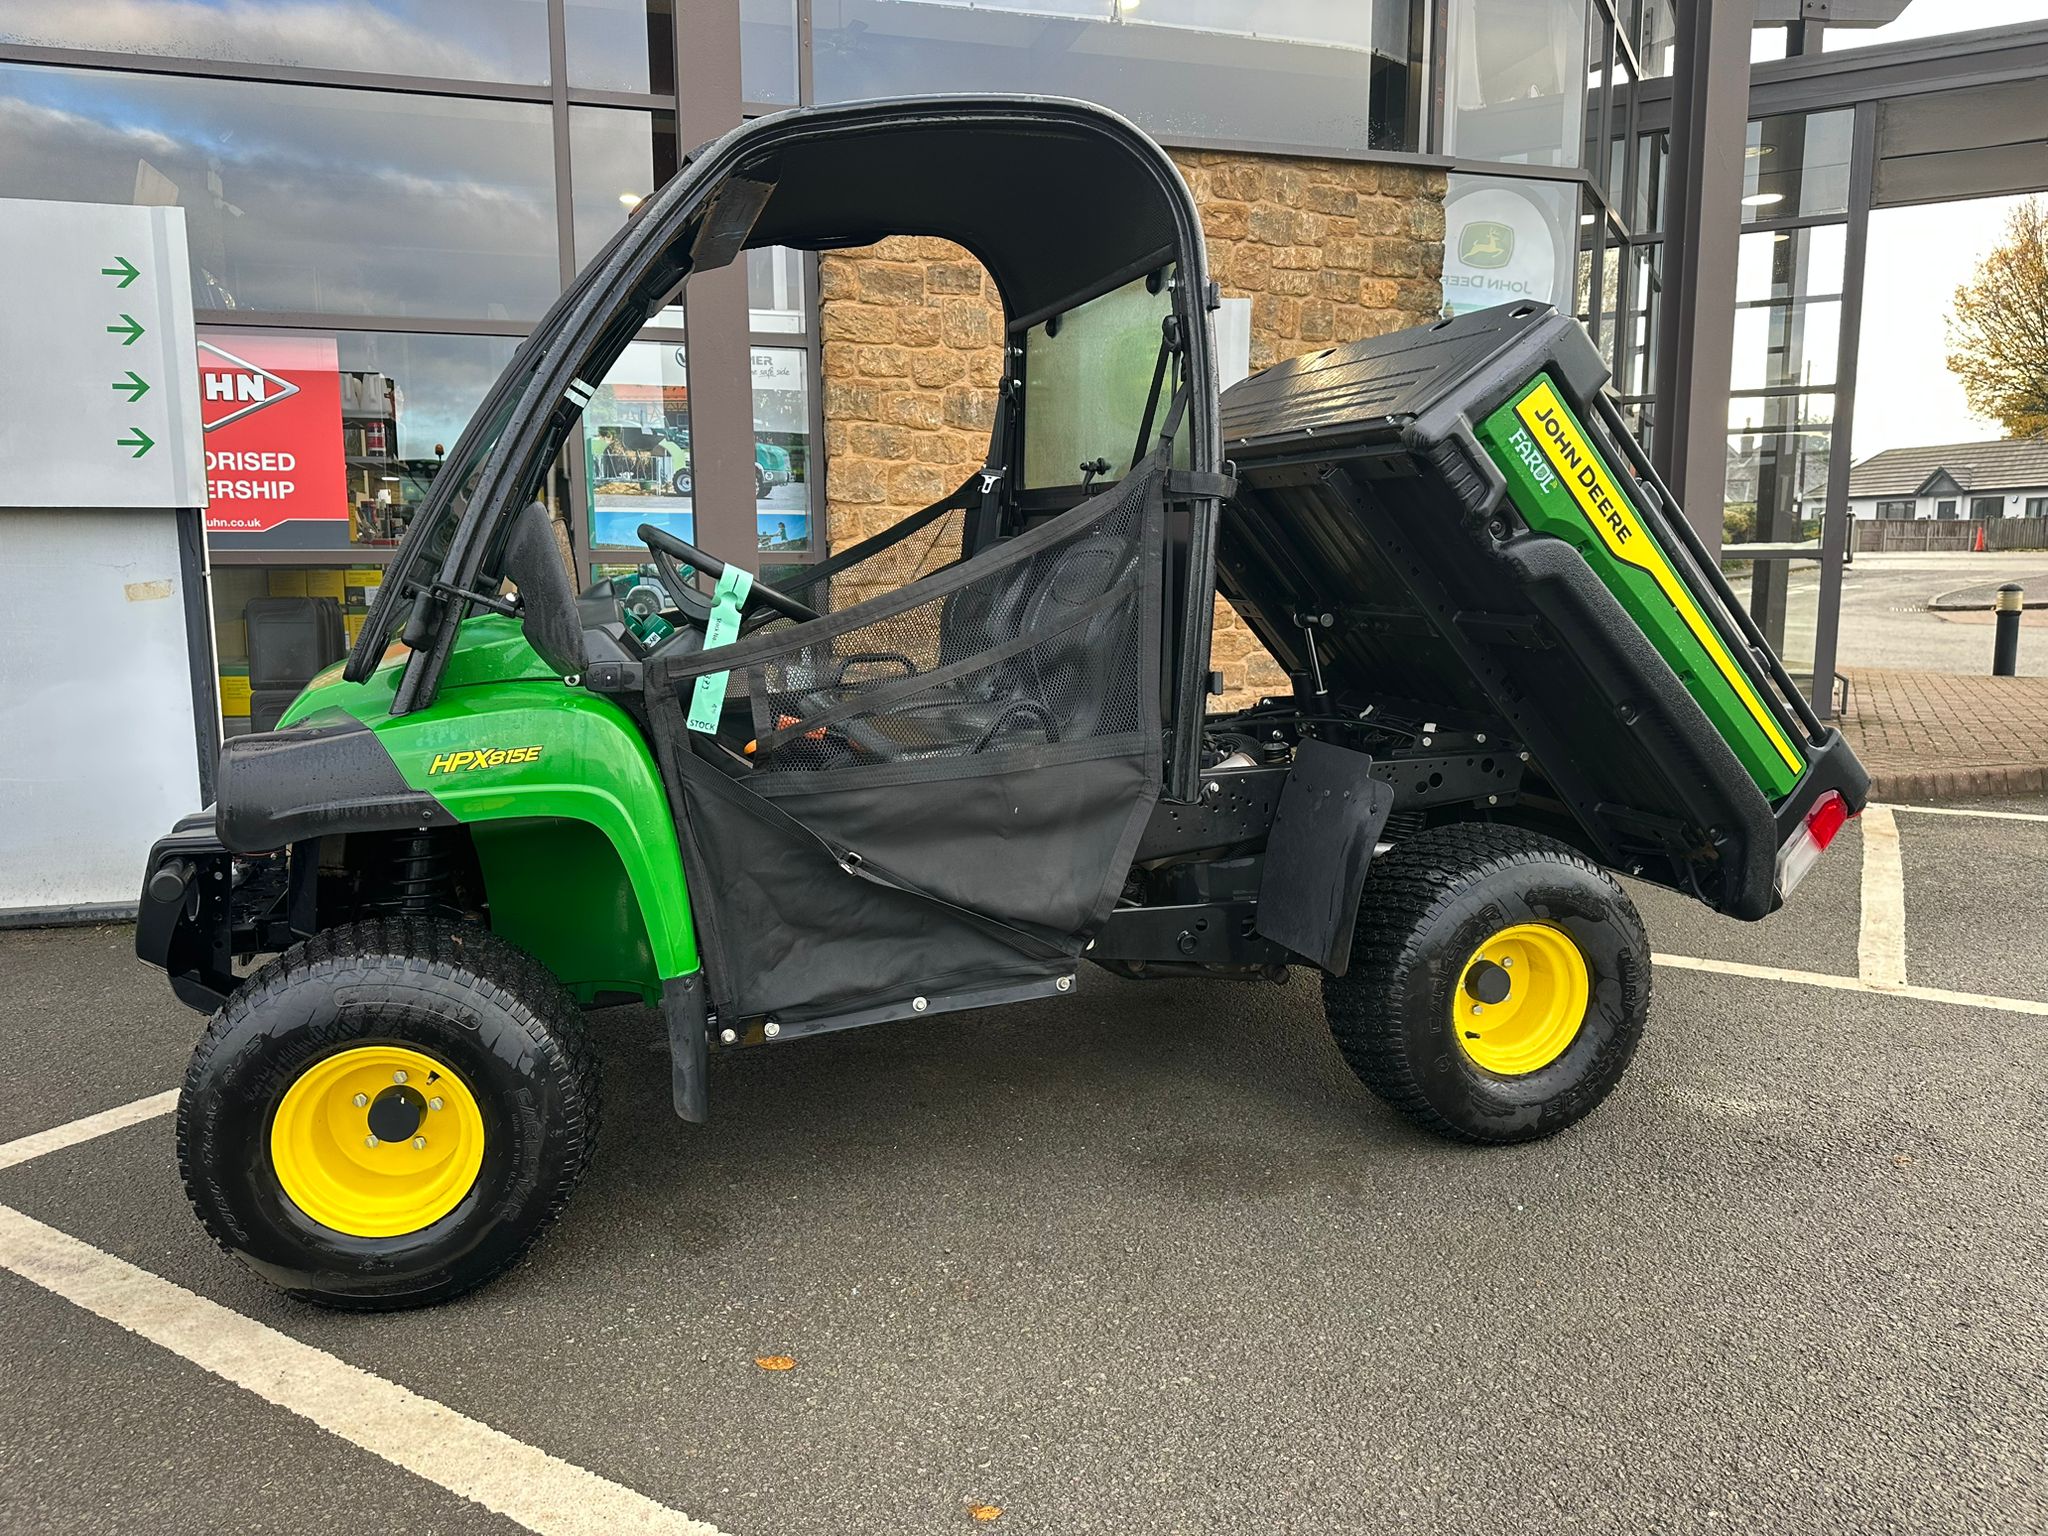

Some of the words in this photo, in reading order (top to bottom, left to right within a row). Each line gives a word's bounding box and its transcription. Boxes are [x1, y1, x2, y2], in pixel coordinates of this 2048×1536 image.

[776, 367, 791, 376] side
[1508, 427, 1555, 494] FAROL
[1534, 407, 1582, 470] JOHN
[1577, 464, 1633, 545] DEERE
[689, 719, 716, 731] STOCK
[428, 744, 544, 775] HPX815E
